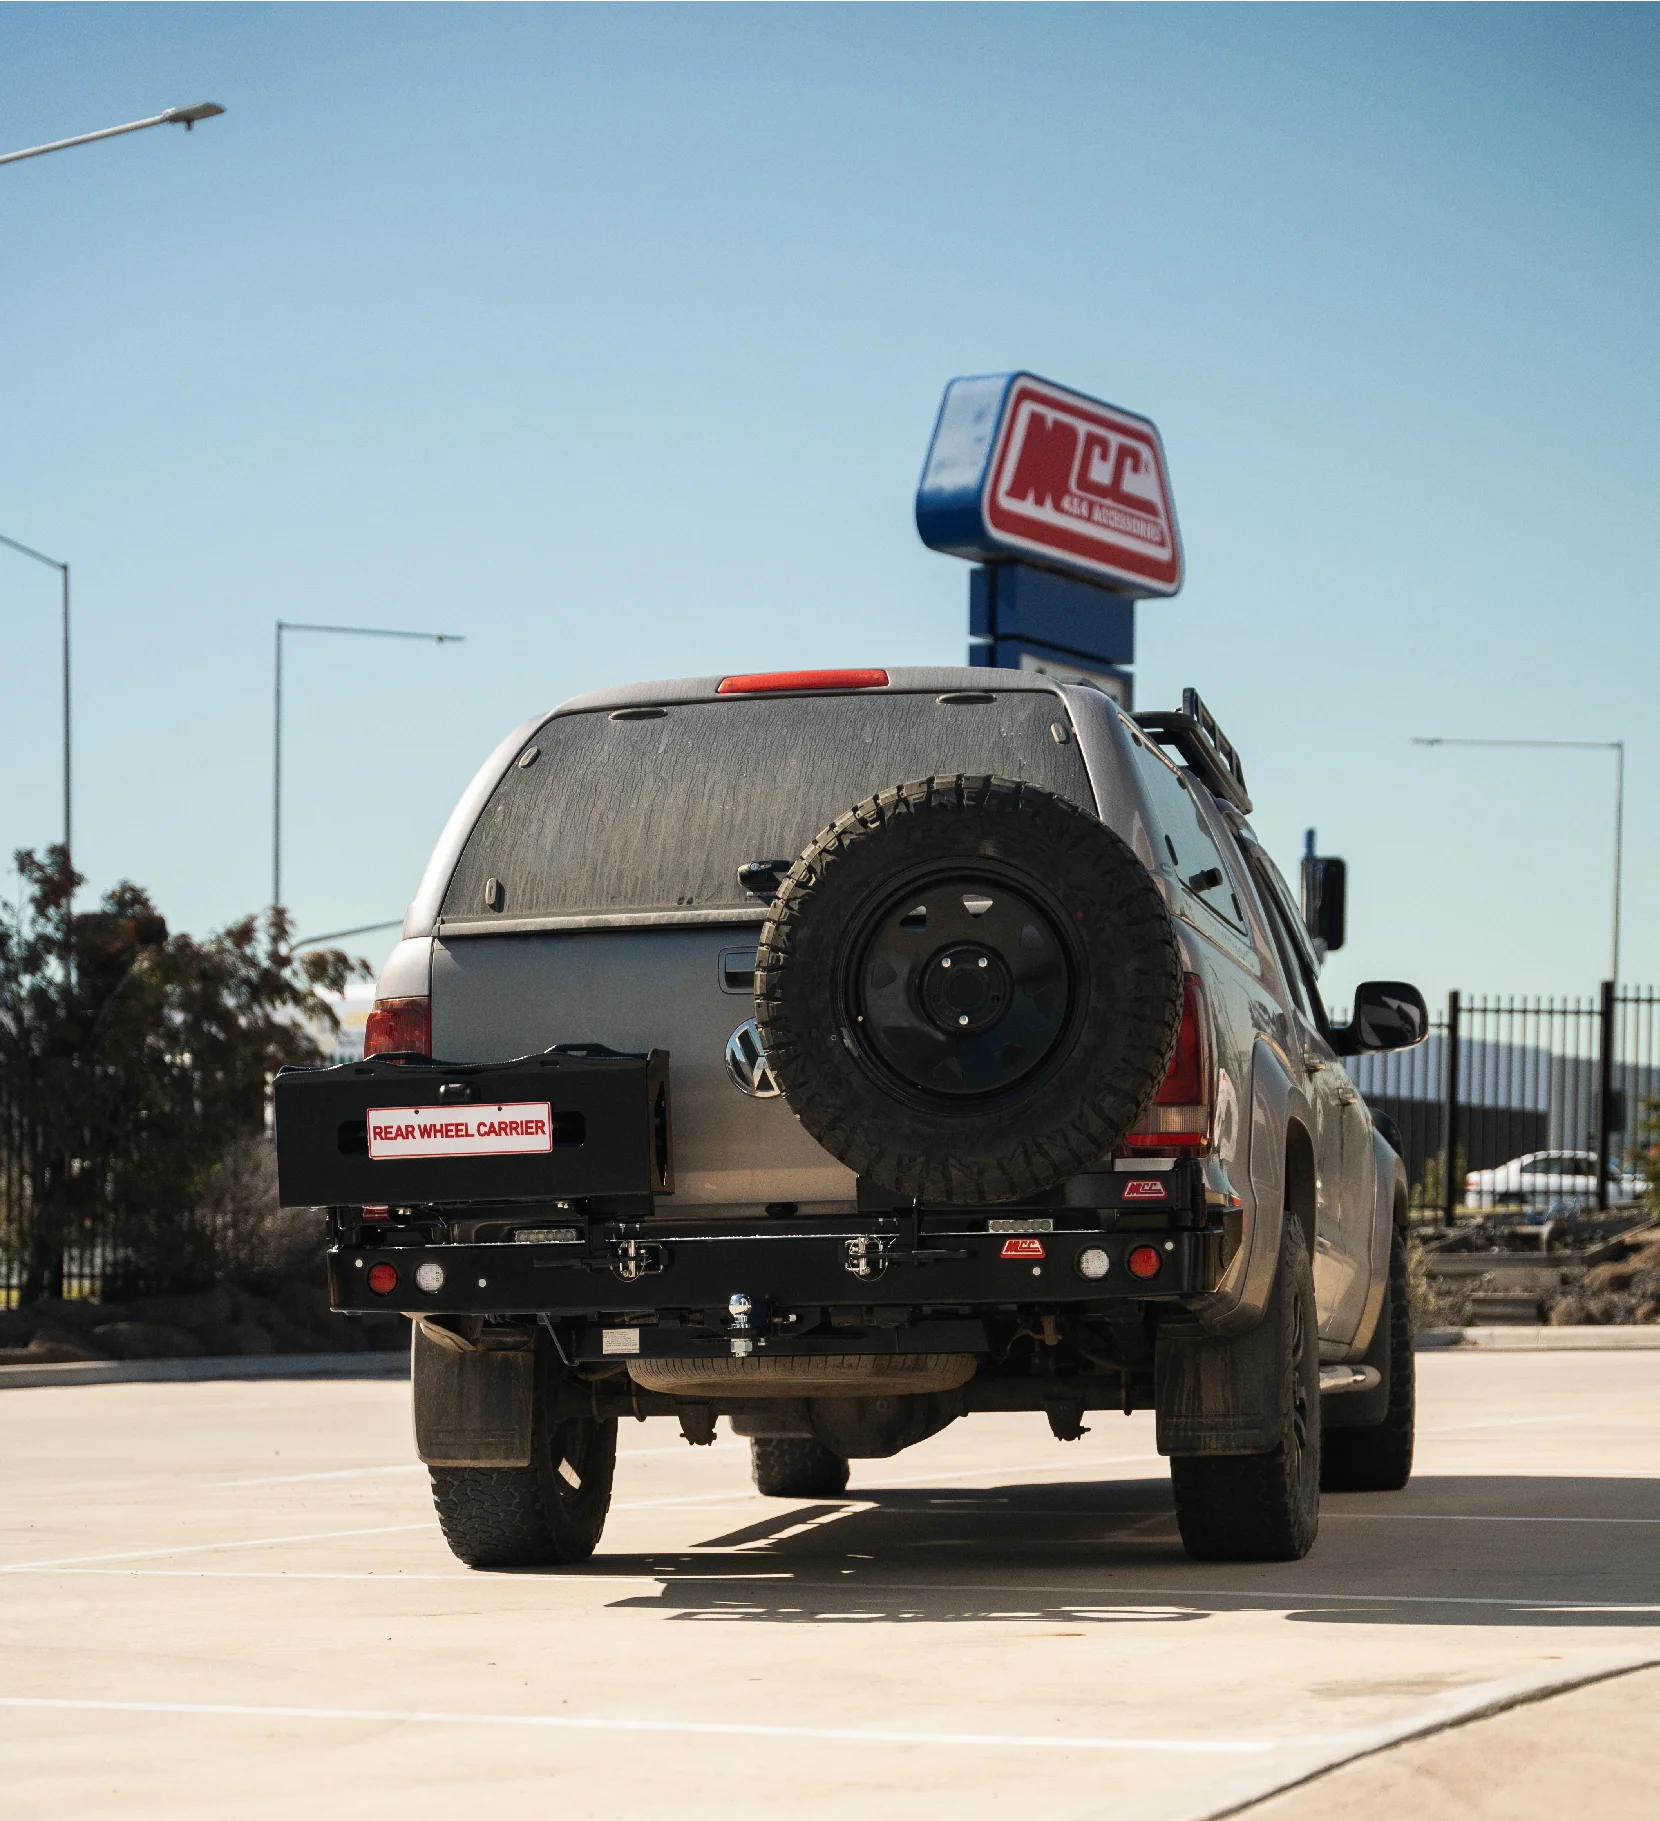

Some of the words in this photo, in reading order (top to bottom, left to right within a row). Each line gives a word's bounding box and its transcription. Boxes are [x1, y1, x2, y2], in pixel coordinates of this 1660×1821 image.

[1005, 410, 1161, 517] MCC
[373, 1125, 416, 1140] REAR
[418, 1122, 474, 1138] WHEEL
[477, 1120, 546, 1136] CARRIER
[1126, 1182, 1164, 1196] MCC
[1003, 1240, 1042, 1253] MCC
